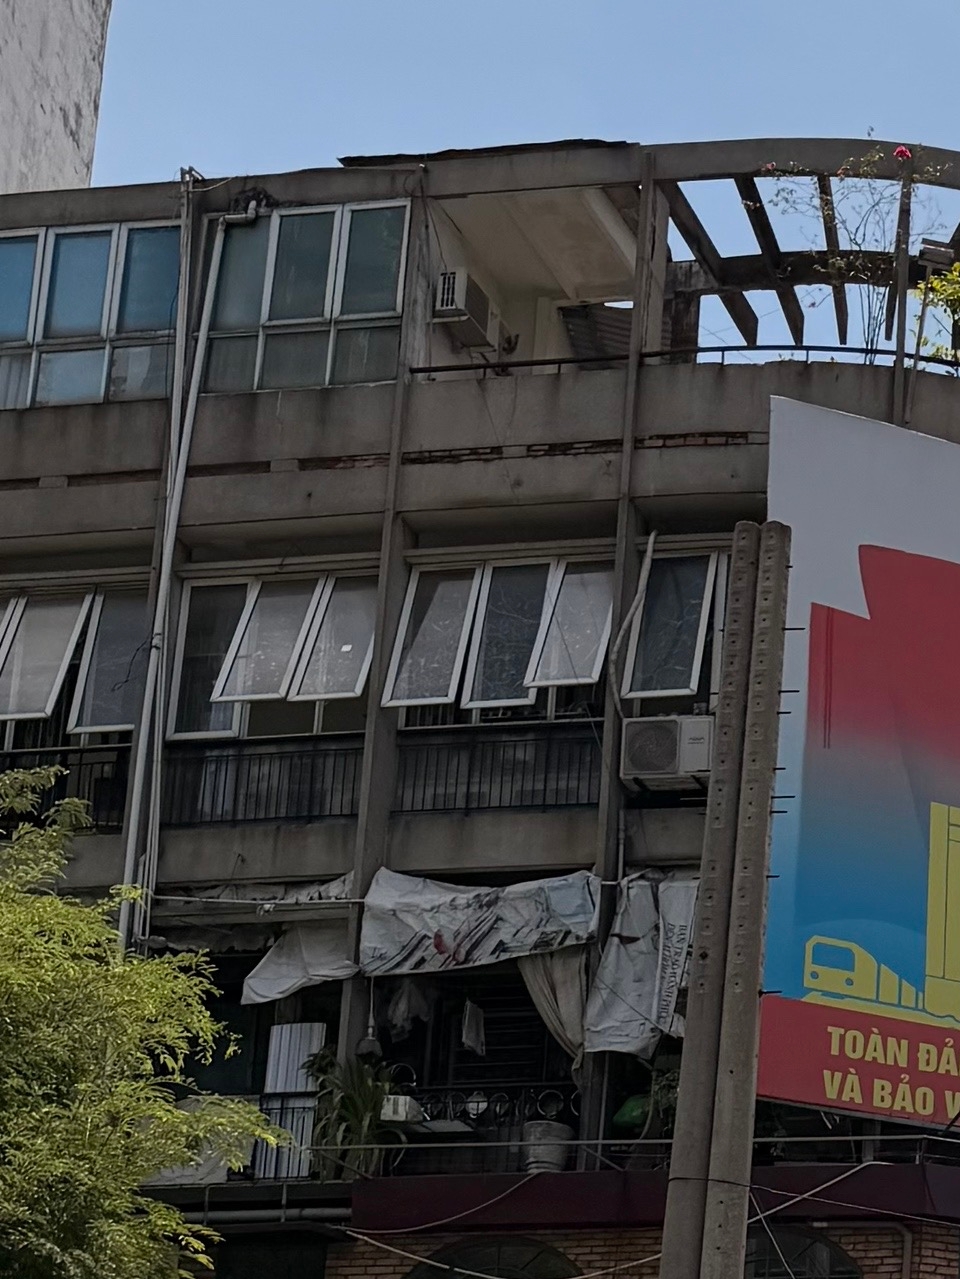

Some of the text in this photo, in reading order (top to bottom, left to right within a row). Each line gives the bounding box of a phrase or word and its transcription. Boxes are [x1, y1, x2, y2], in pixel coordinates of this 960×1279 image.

[827, 1026, 909, 1068] TOÀN
[823, 1068, 863, 1104] VÀ
[873, 1073, 934, 1116] BẢO
